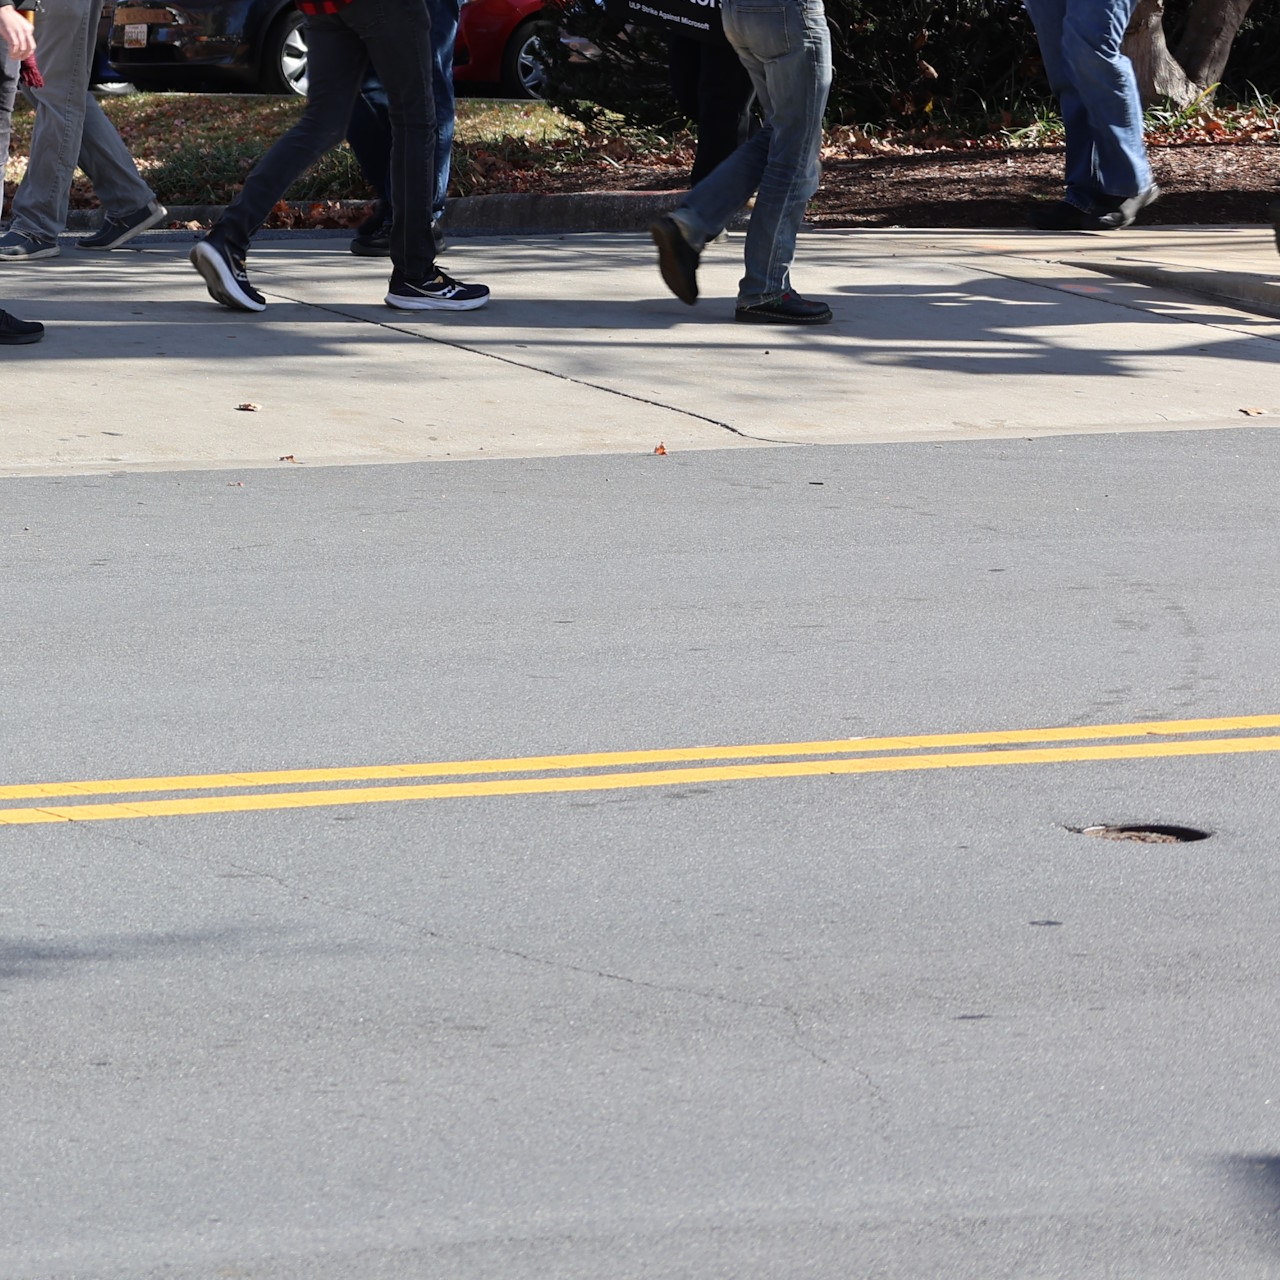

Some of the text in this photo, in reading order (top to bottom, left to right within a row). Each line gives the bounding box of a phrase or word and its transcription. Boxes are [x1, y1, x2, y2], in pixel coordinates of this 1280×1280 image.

[628, 0, 710, 31] ULP Strike Against Microsoft
